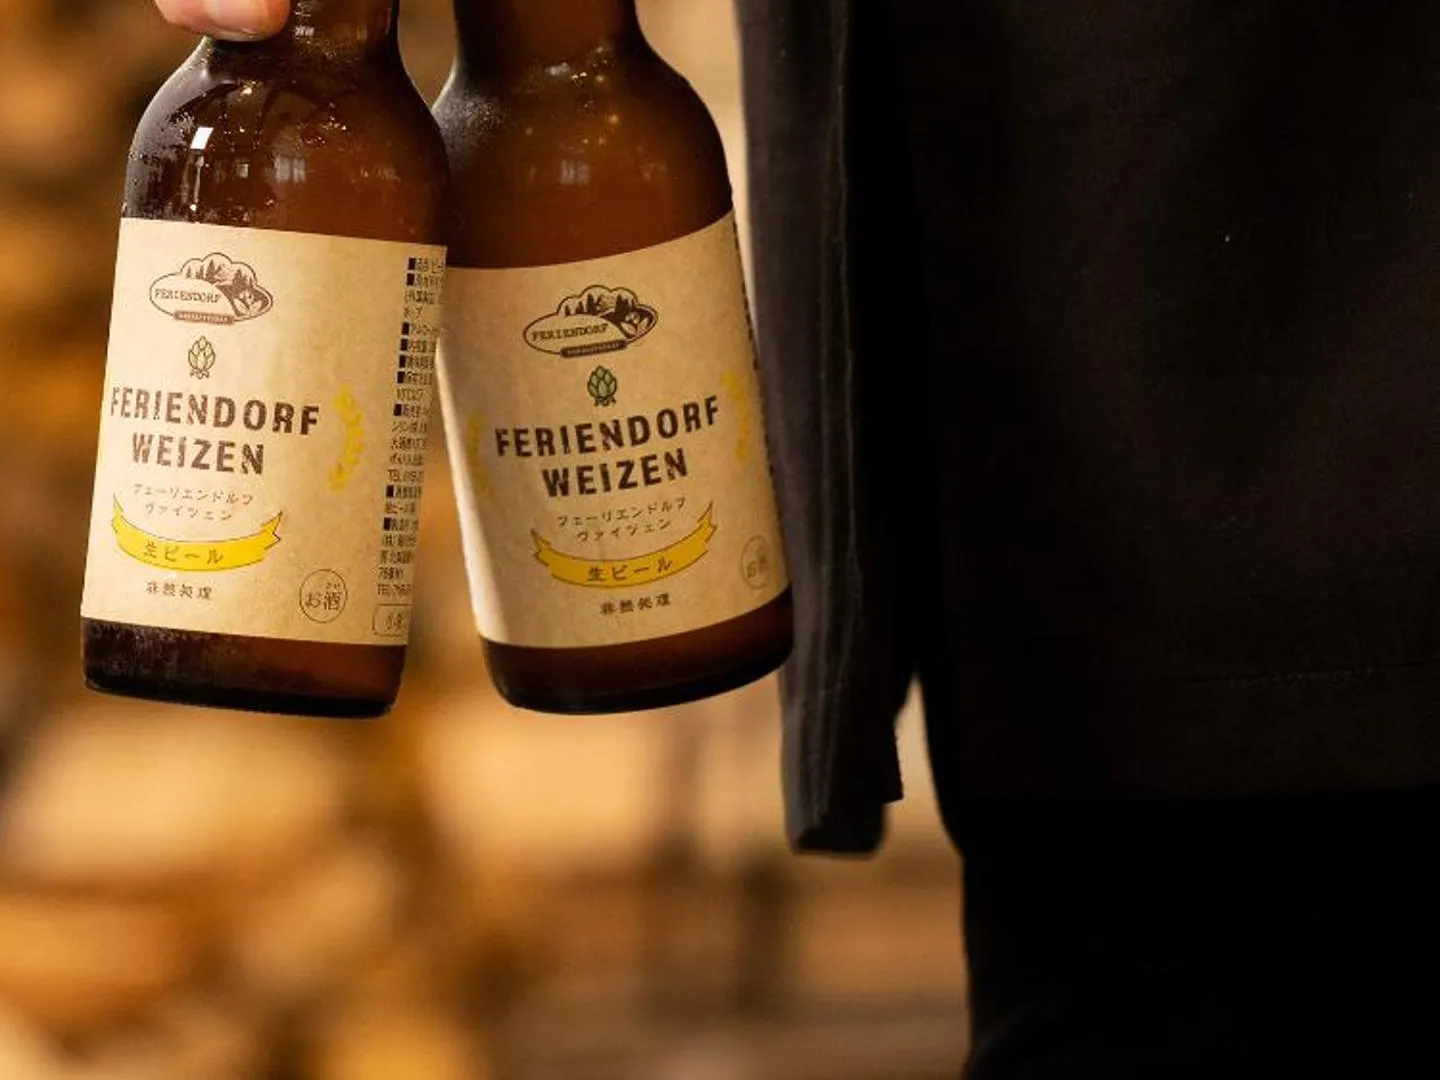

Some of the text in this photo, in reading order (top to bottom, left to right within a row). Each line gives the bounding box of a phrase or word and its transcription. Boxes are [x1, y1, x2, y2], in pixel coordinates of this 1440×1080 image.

[154, 288, 222, 304] FERIENDORF
[531, 323, 609, 341] FERIENDORF
[110, 386, 320, 436] FERIENDORF
[494, 395, 720, 458] FERIENDORF
[131, 431, 265, 475] WEIZEN
[542, 447, 689, 498] WEIZEN
[143, 539, 224, 565] 生ビール
[586, 556, 673, 583] 生ビール
